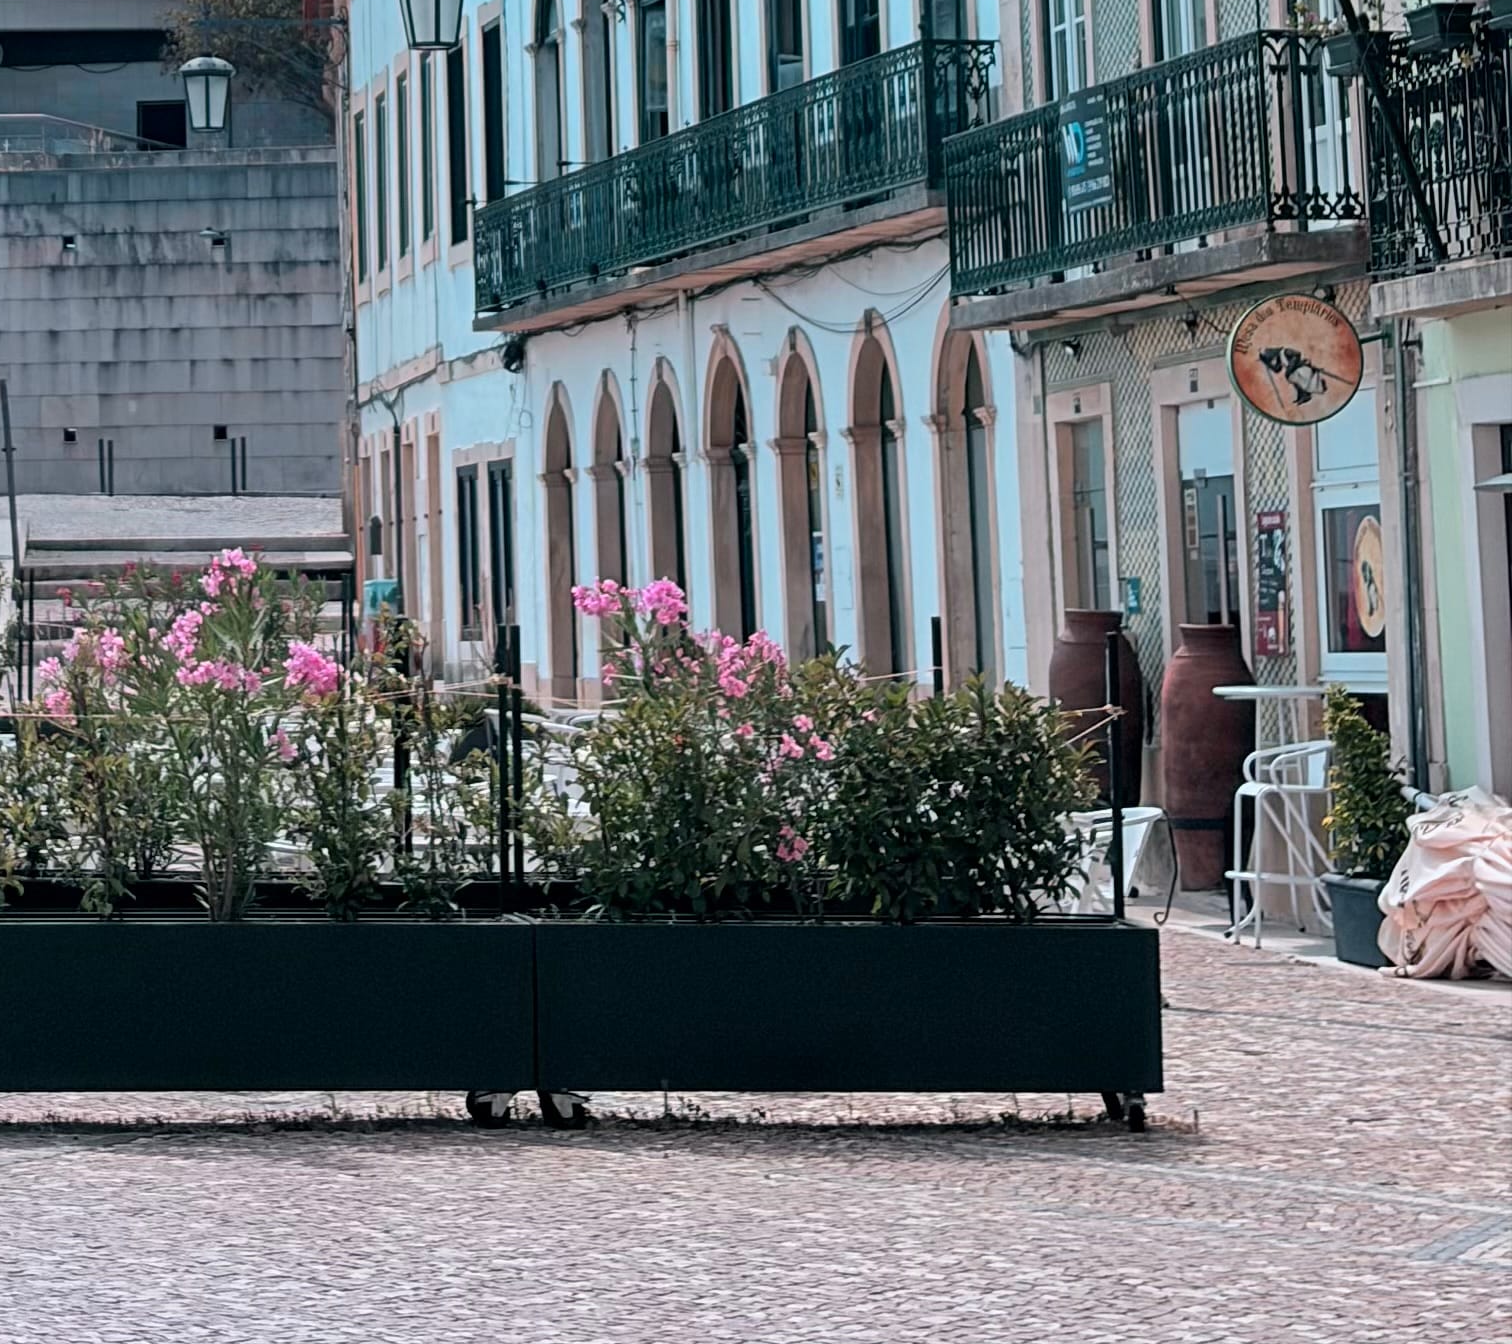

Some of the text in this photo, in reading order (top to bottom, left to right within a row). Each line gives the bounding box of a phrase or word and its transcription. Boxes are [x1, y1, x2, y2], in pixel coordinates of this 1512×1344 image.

[1235, 297, 1339, 354] Mesa dos Templários
